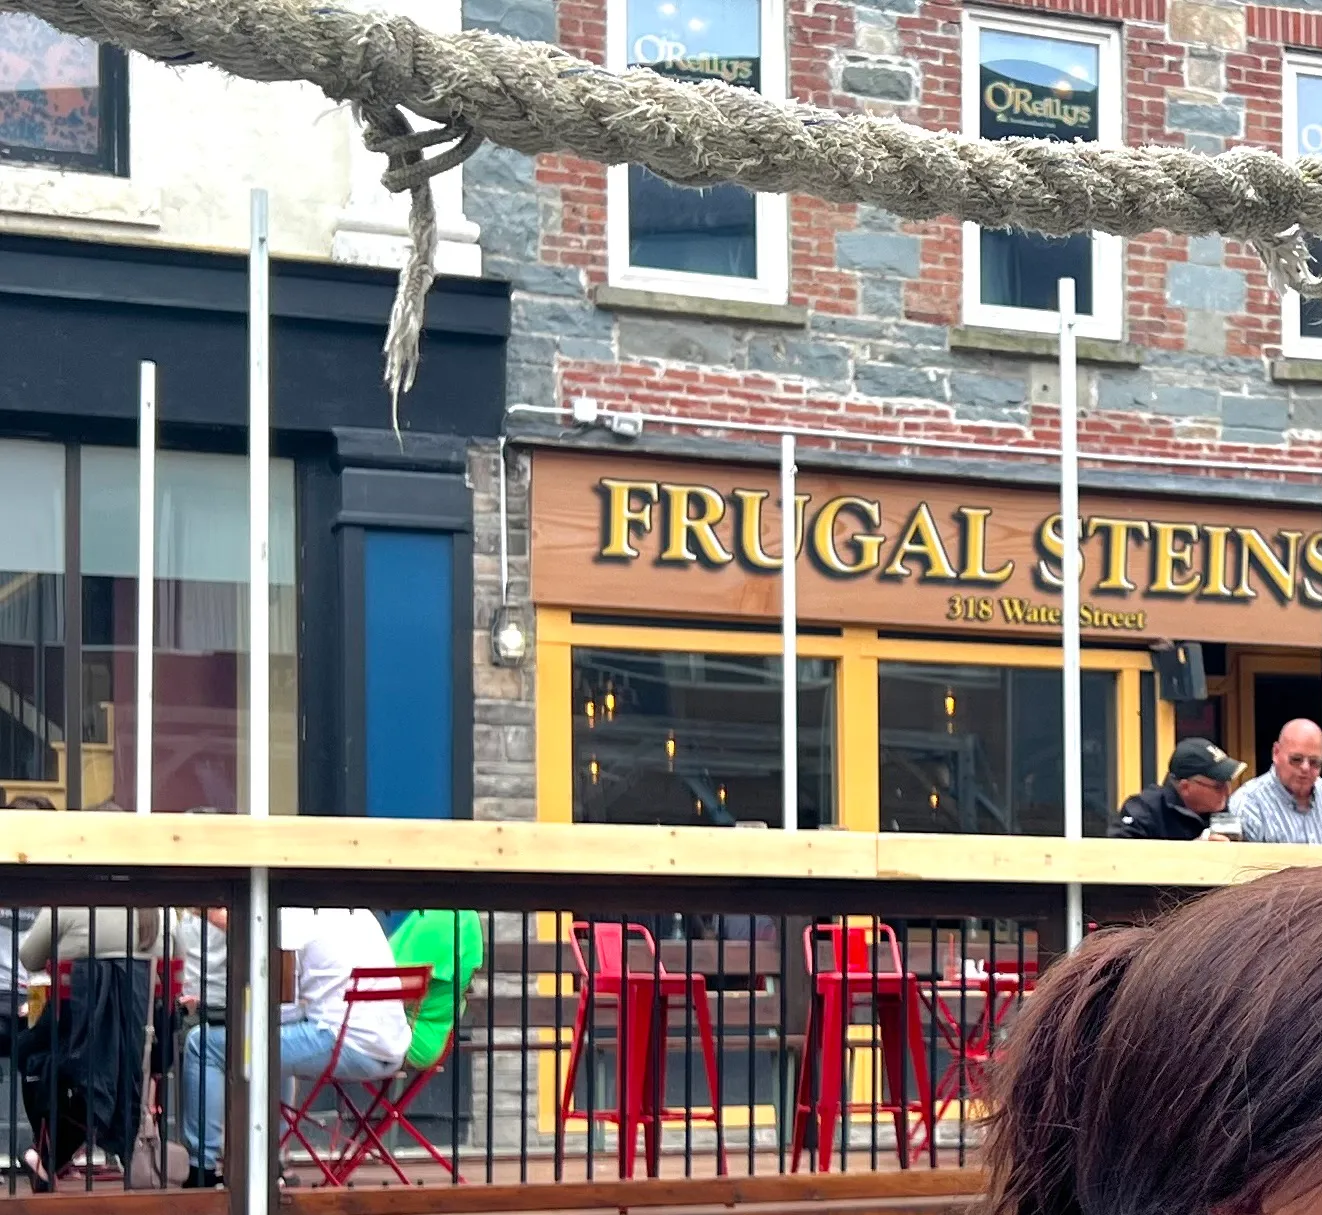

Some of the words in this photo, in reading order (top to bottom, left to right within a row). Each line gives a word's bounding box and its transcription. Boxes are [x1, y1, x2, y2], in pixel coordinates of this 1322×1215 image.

[598, 478, 1015, 583] FRUGAL
[948, 594, 993, 621] 318
[1000, 597, 1064, 625] Wate
[1080, 602, 1145, 630] Street
